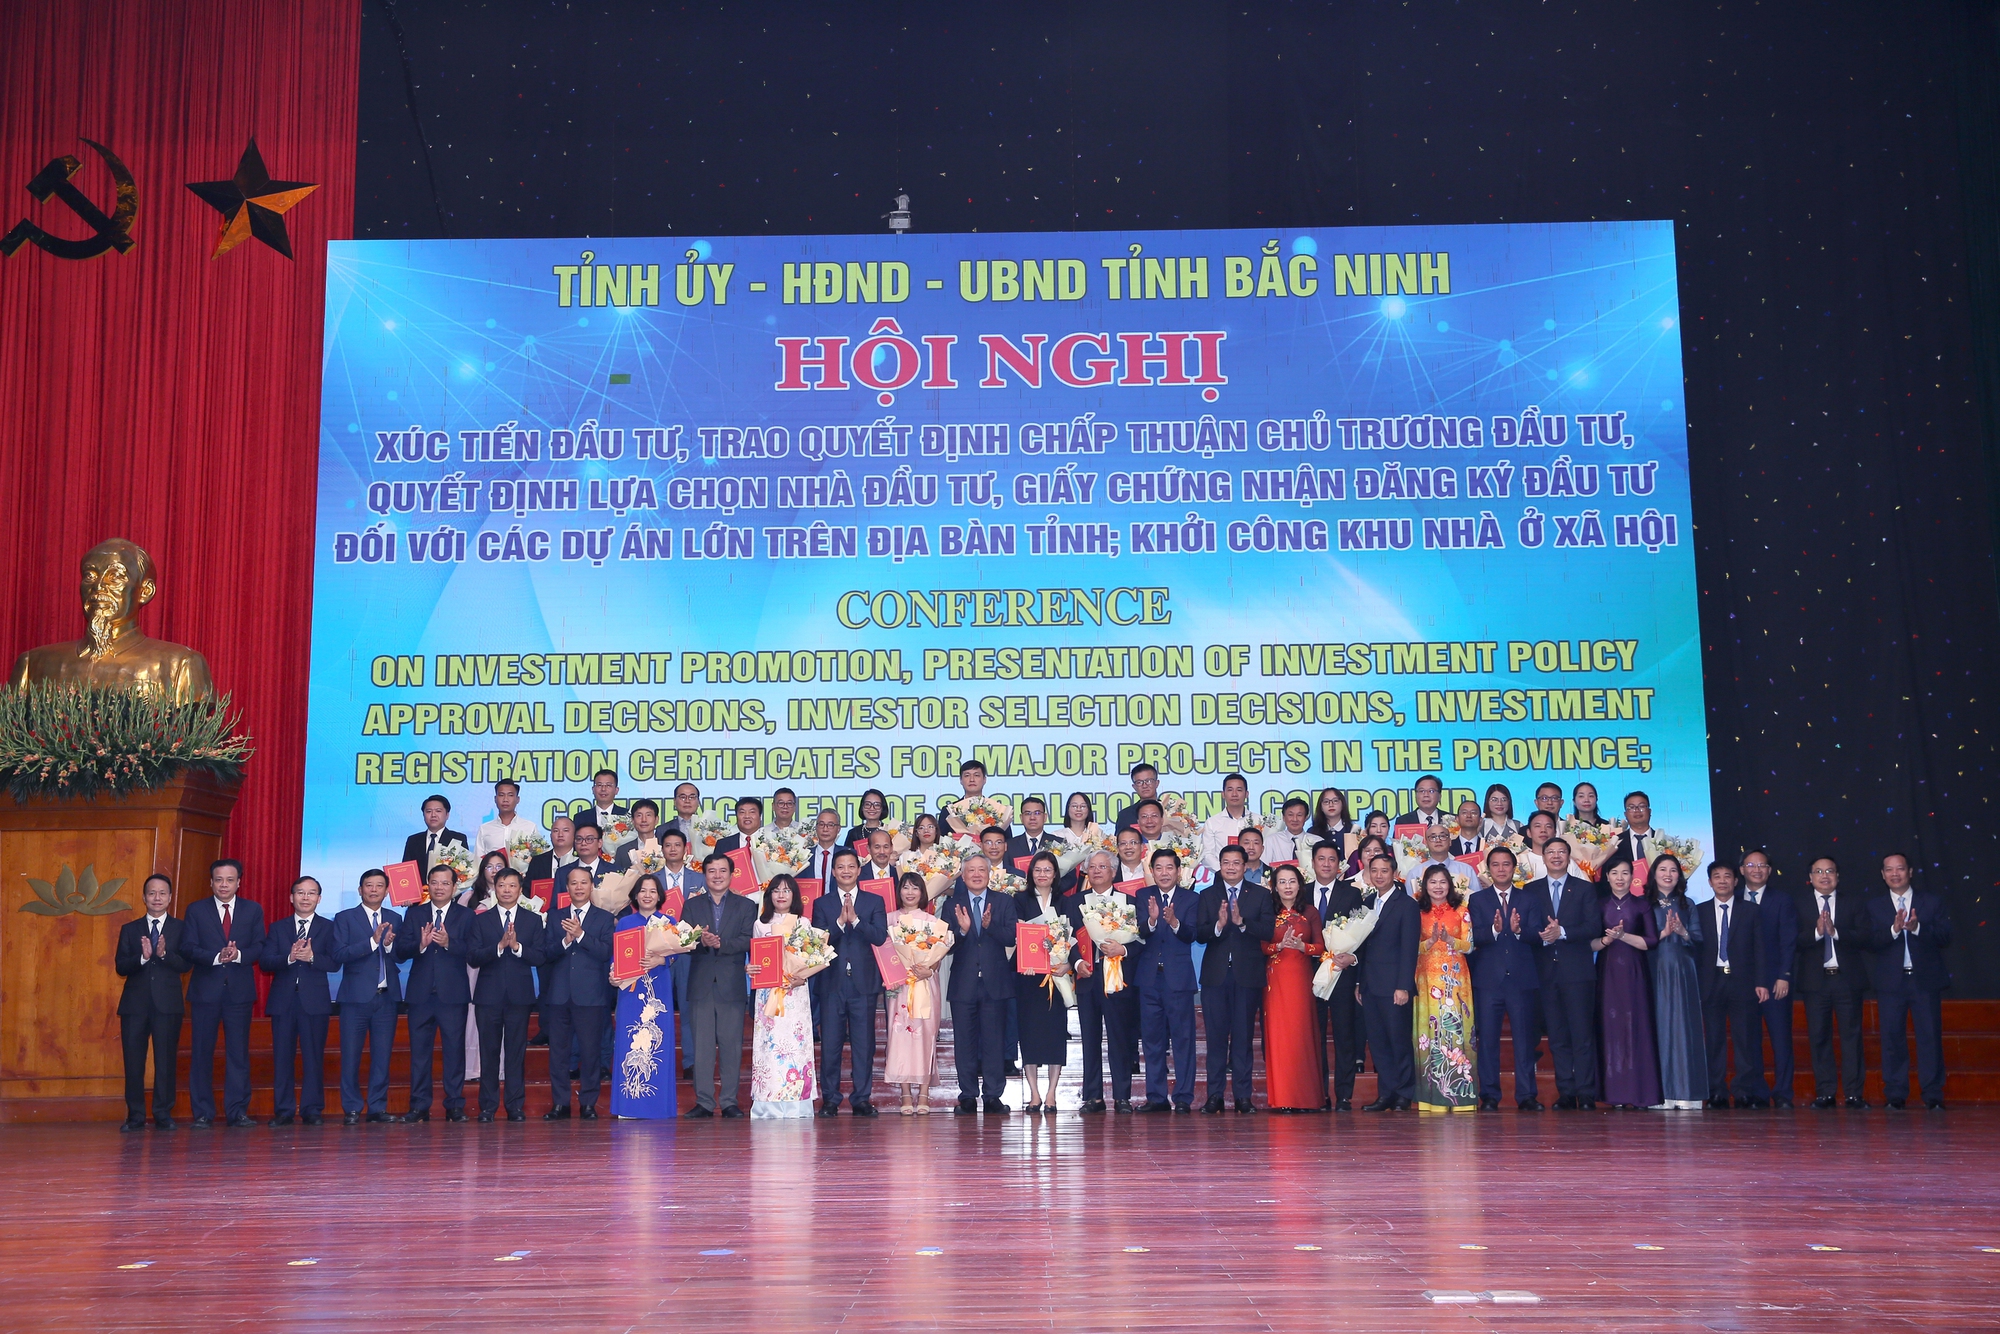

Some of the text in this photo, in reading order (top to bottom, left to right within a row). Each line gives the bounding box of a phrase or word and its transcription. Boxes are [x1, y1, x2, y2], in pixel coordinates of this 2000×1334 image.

[553, 251, 659, 307] TỈNH
[675, 250, 735, 307] ỦY
[782, 260, 910, 305] HĐND
[959, 258, 1087, 303] UBND
[1102, 245, 1209, 300] TỈNH
[1225, 238, 1318, 298] BẮC
[1334, 252, 1451, 296] NINH
[775, 317, 1227, 408] HỘI NGHỊ
[375, 405, 1635, 464] XÚC TIẾN ĐẦU TƯ, TRAO QUYẾT ĐỊNH CHẤP THUẬN CHỦ TRƯƠNG ĐẦU TƯ,
[367, 455, 1657, 518] QUYẾT ĐỊNH LỰA CHỌN NHÀ ĐẦU TƯ, GIẤY CHỨNG NHẬN ĐĂNG KÝ ĐẦU TƯ
[333, 507, 1679, 568] ĐỐI VỚI CÁC DỰ ÁN LỚN TRÊN ĐỊA BÀN TỈNH; KHỞI CÔNG KHU NHÀ Ở XÃ HỘI
[836, 587, 1172, 630] CONFERENCE
[372, 639, 1639, 688] ON INVESTMENT PROMOTION, PRESENTATION OF INVESTMENT POLICY
[362, 688, 1654, 736] APPROVAL DECISIONS, INVESTOR SELECTION DECISIONS, INVESTMENT
[356, 737, 1652, 785] REGISTRATION CERTIFICATES FOR MAJOR PROJECTS IN THE PROVINCE;
[883, 794, 926, 827] OF
